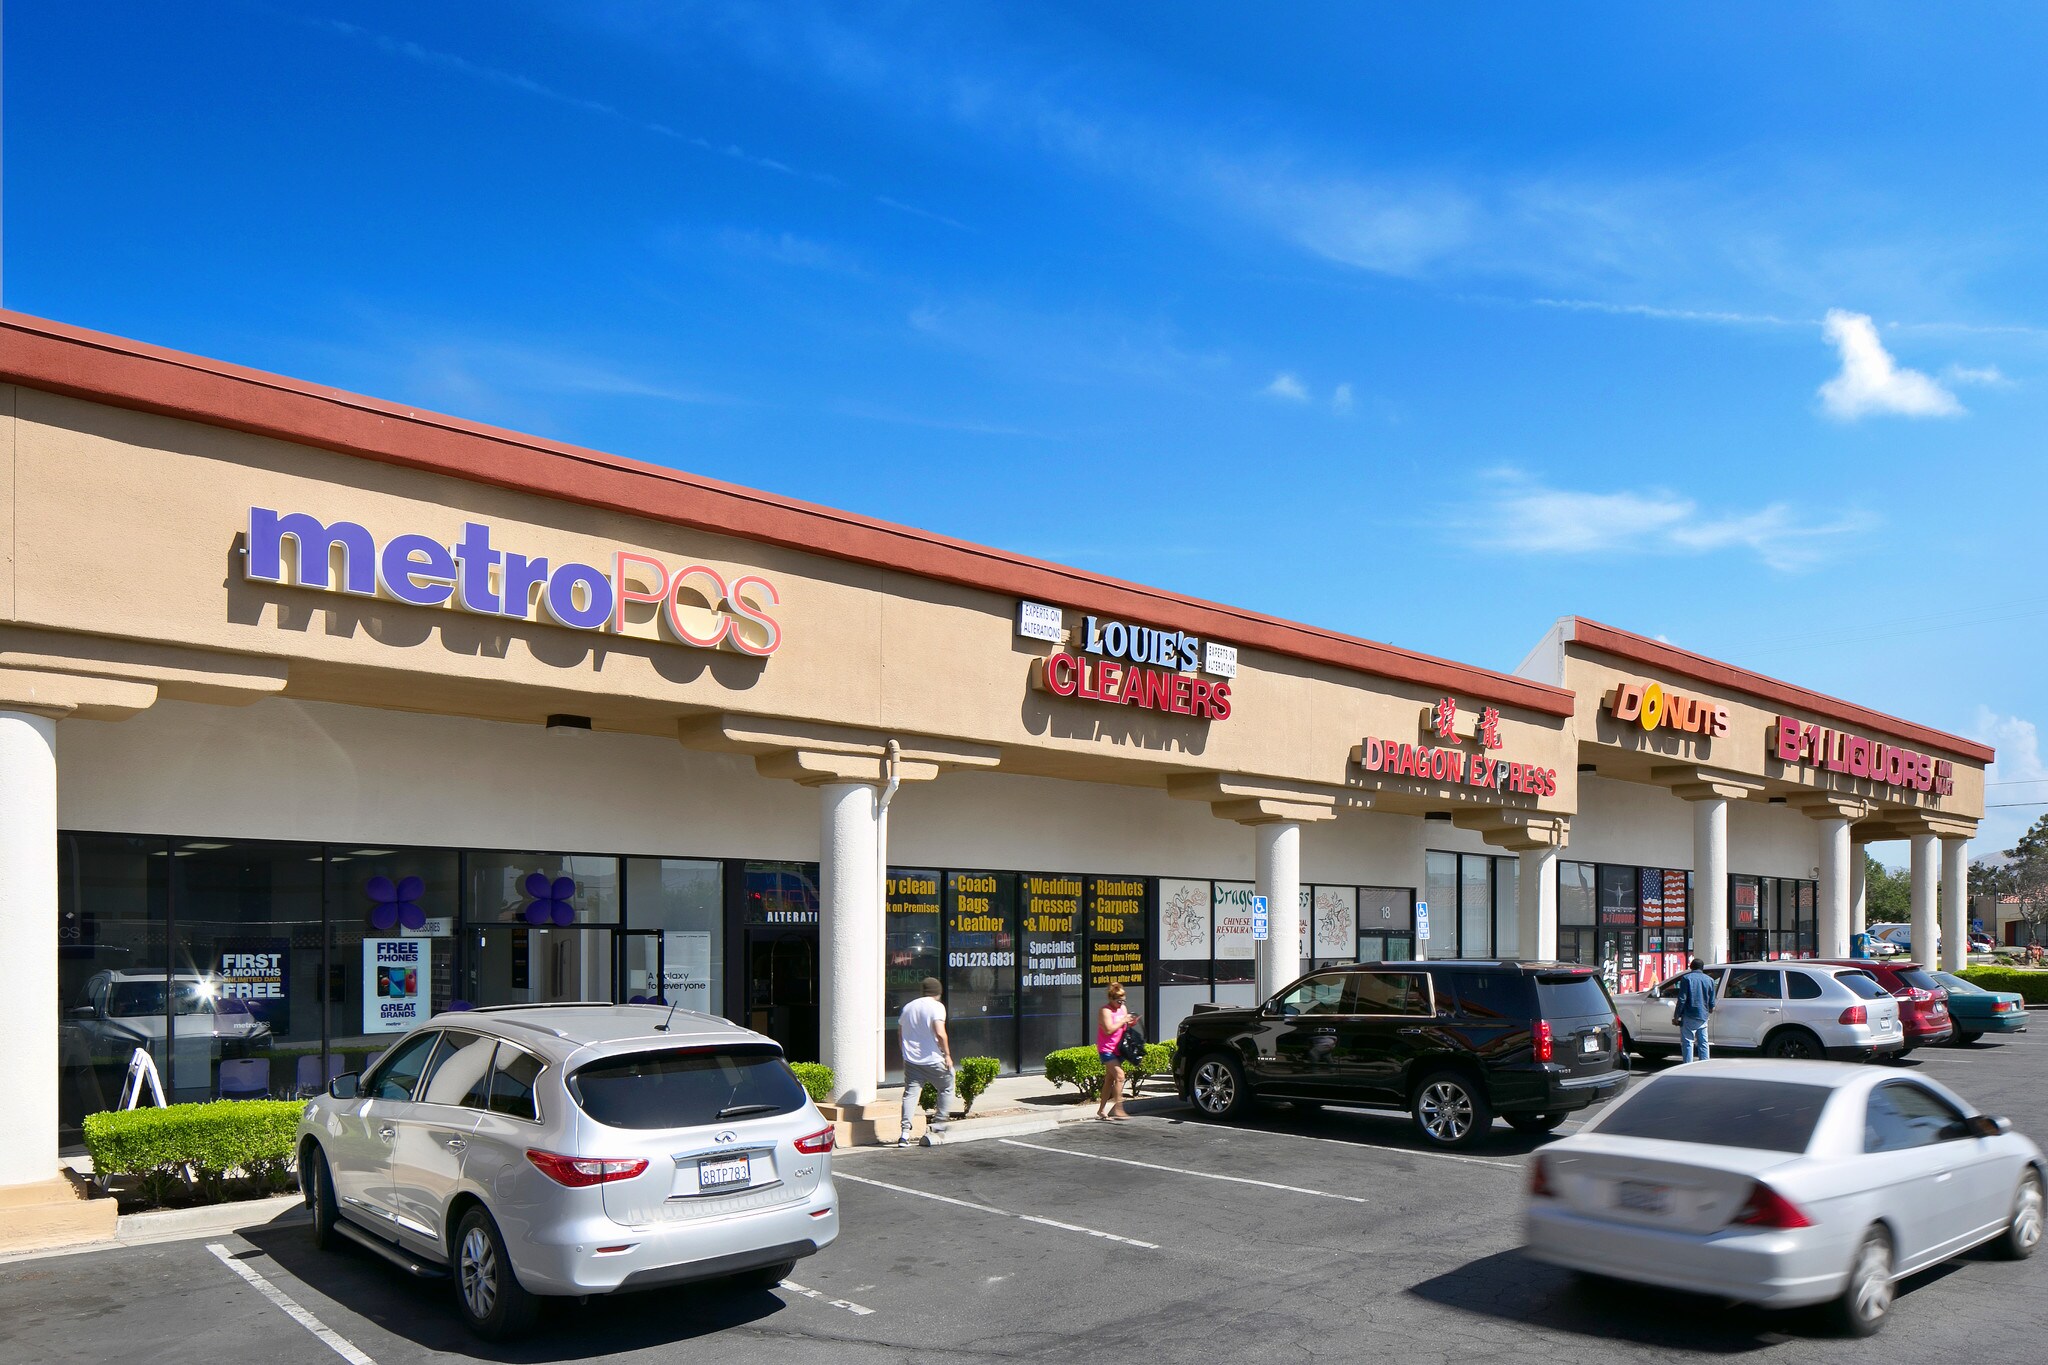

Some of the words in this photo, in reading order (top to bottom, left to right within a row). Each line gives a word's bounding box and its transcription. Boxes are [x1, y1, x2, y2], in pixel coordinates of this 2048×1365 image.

[246, 504, 783, 657] metroPCS
[1025, 604, 1048, 619] EXPERTS
[1050, 608, 1060, 622] ON
[1023, 622, 1061, 640] ALTERATIONS
[1084, 616, 1199, 672] LOUIE'S
[1208, 645, 1229, 660] EXPERTS
[1230, 651, 1236, 662] ON
[1208, 658, 1236, 675] ALTERATIONS
[1048, 652, 1233, 721] CLEANERS
[1616, 683, 1731, 738] DONUTS
[1366, 736, 1462, 783] DRAGON
[1470, 753, 1557, 797] EXPRESS
[1825, 729, 1933, 791] LIQUORS
[898, 877, 936, 895] clean
[957, 875, 997, 893] Coach
[1030, 877, 1082, 897] Wedding
[1096, 879, 1144, 896] Blankets
[892, 903, 903, 913] on
[903, 902, 940, 913] Premises
[957, 895, 989, 914] Bags
[1030, 897, 1077, 914] dresses
[1097, 897, 1139, 915] Carpets
[1381, 906, 1391, 919] 18
[957, 915, 1004, 932] Leather
[1027, 917, 1037, 932] &
[1038, 915, 1073, 932] More!
[1097, 915, 1124, 934] Rugs
[1223, 917, 1252, 926] CHINESE
[376, 942, 419, 954] FREE
[1029, 940, 1075, 955] Specialist
[1094, 943, 1110, 952] Same
[1109, 943, 1120, 952] day
[1120, 942, 1140, 951] service
[222, 953, 282, 969] FIRST
[376, 954, 419, 962] PHONES
[948, 952, 1015, 967] 661.273.6831
[1028, 956, 1039, 970] in
[1039, 958, 1056, 970] any
[1057, 955, 1077, 969] kind
[1092, 954, 1113, 962] Monday
[1125, 953, 1141, 962] Friday
[223, 968, 231, 977] 2
[232, 968, 282, 977] MONTHS
[1112, 963, 1130, 972] before
[647, 972, 654, 980] A
[656, 972, 689, 981] alaxy
[1022, 973, 1033, 987] of
[1033, 972, 1082, 986] alterations
[222, 982, 286, 999] FREE.
[664, 982, 706, 992] everyone
[380, 1002, 417, 1012] GREAT
[380, 1011, 417, 1019] BRANDS
[233, 1021, 271, 1029] metroPCS
[703, 1165, 747, 1185] 8BTP783
